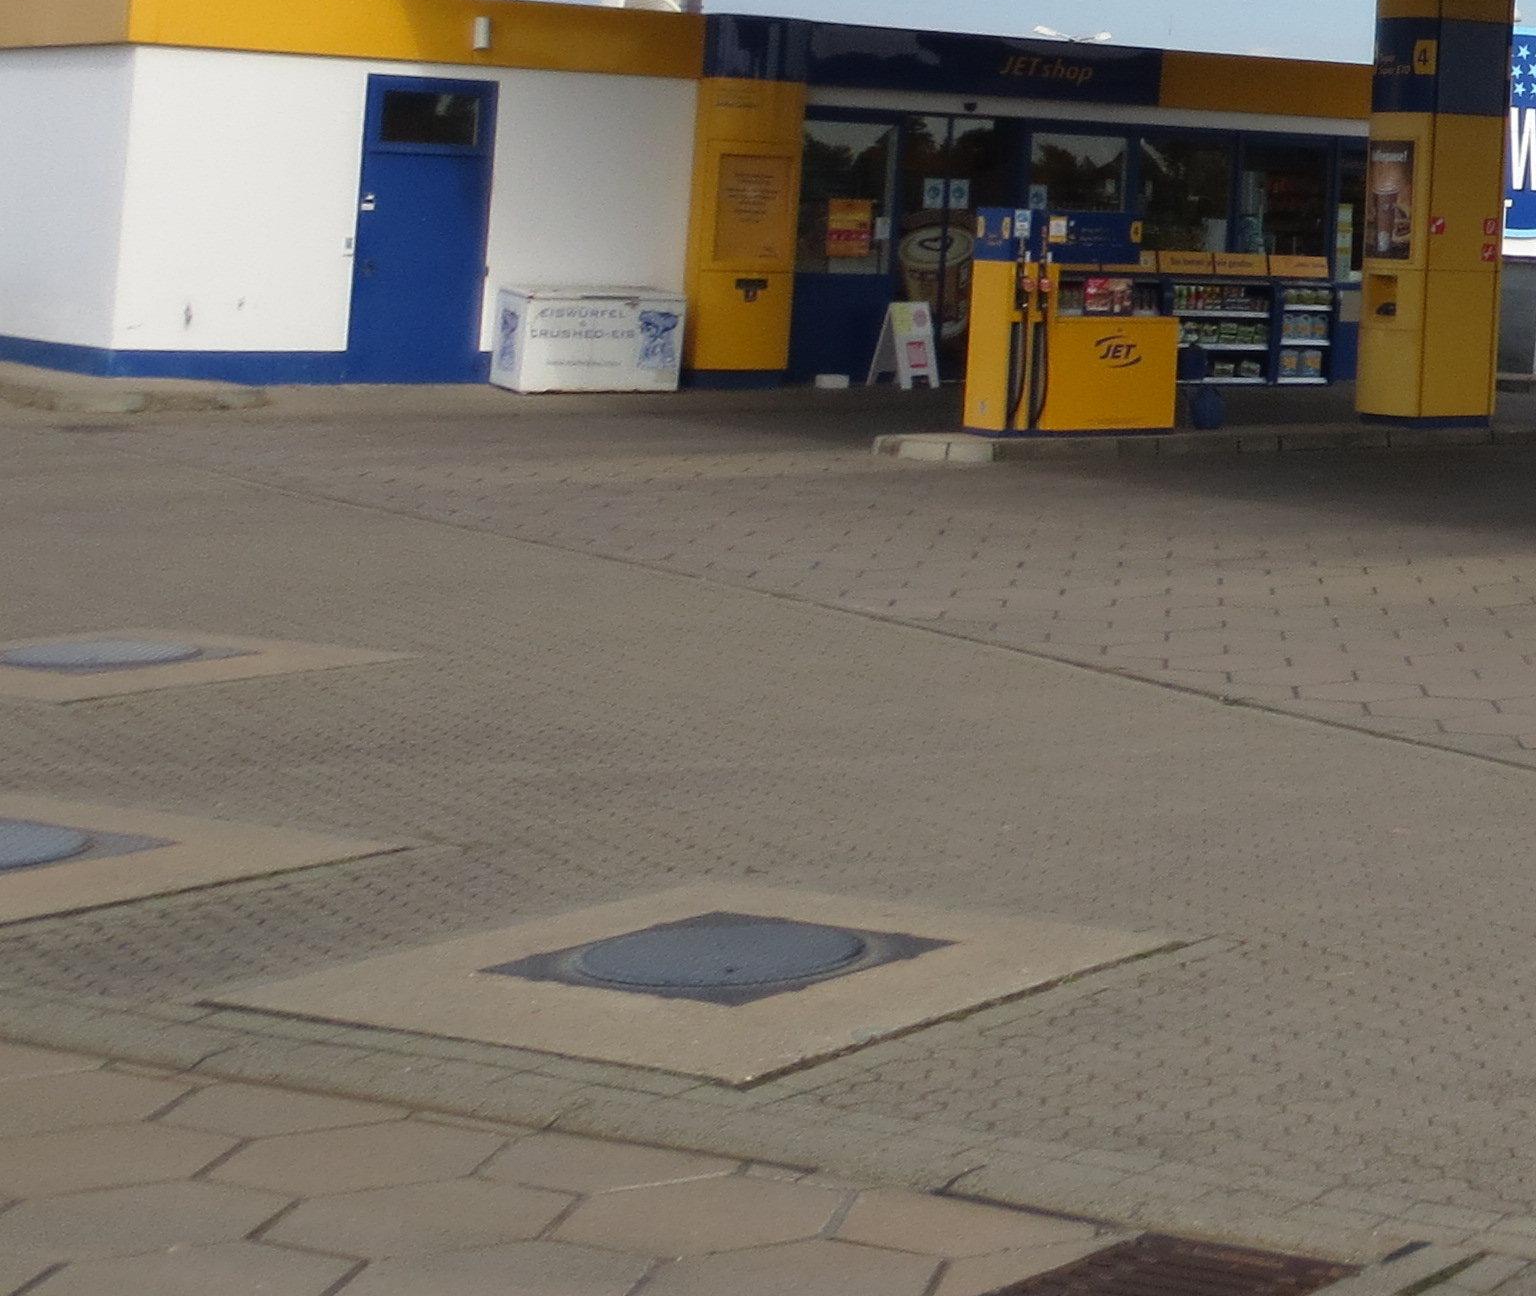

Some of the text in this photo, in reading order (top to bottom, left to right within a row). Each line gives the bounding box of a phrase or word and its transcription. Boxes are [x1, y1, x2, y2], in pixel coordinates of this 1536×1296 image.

[1418, 48, 1429, 65] 4
[1043, 58, 1093, 86] shop
[1099, 344, 1137, 360] JET
